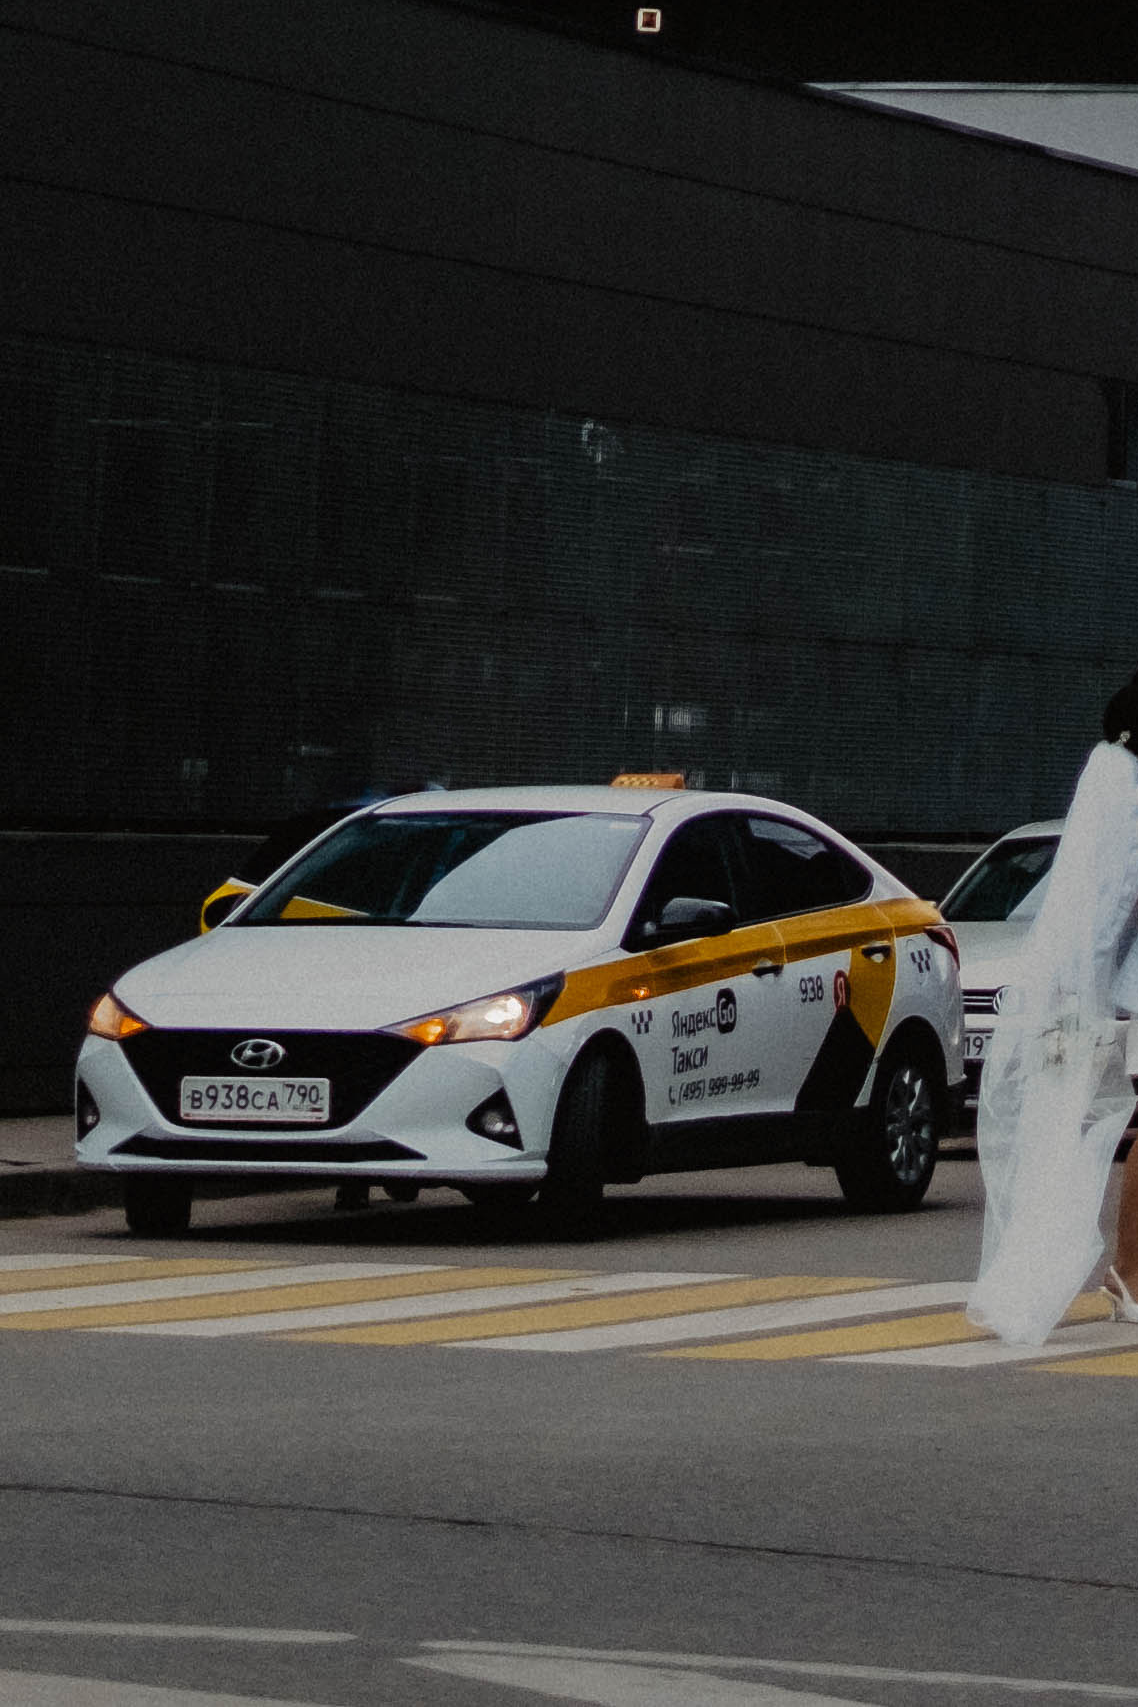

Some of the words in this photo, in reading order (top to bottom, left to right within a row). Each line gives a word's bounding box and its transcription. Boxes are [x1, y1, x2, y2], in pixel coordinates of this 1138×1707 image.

[799, 975, 825, 1003] 938
[671, 1007, 717, 1039] Яндекс
[718, 996, 735, 1026] Go
[671, 1044, 709, 1076] Такси
[283, 1083, 320, 1105] 790
[678, 1078, 706, 1106] (495)
[708, 1068, 760, 1097] 999-99-99
